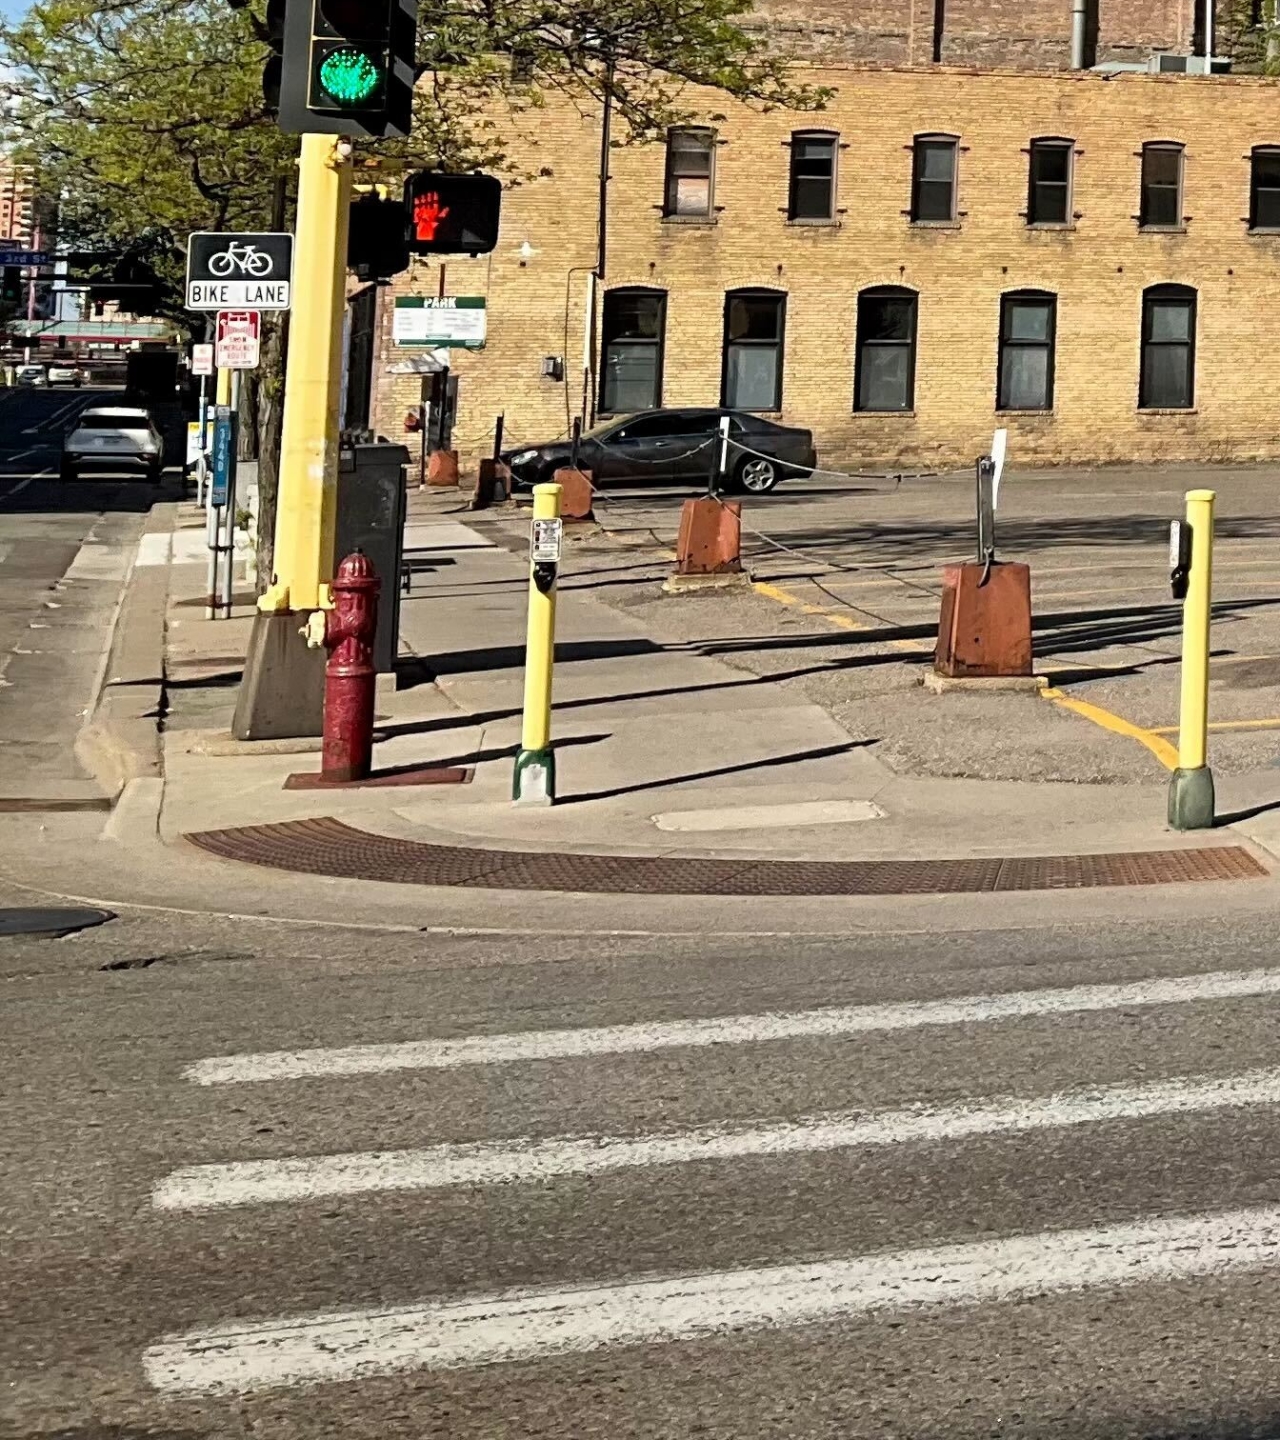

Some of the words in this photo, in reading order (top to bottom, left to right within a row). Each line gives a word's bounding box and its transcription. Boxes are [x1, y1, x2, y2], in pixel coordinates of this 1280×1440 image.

[192, 285, 229, 302] BIKE
[245, 285, 286, 302] LANE
[423, 297, 457, 309] PARK
